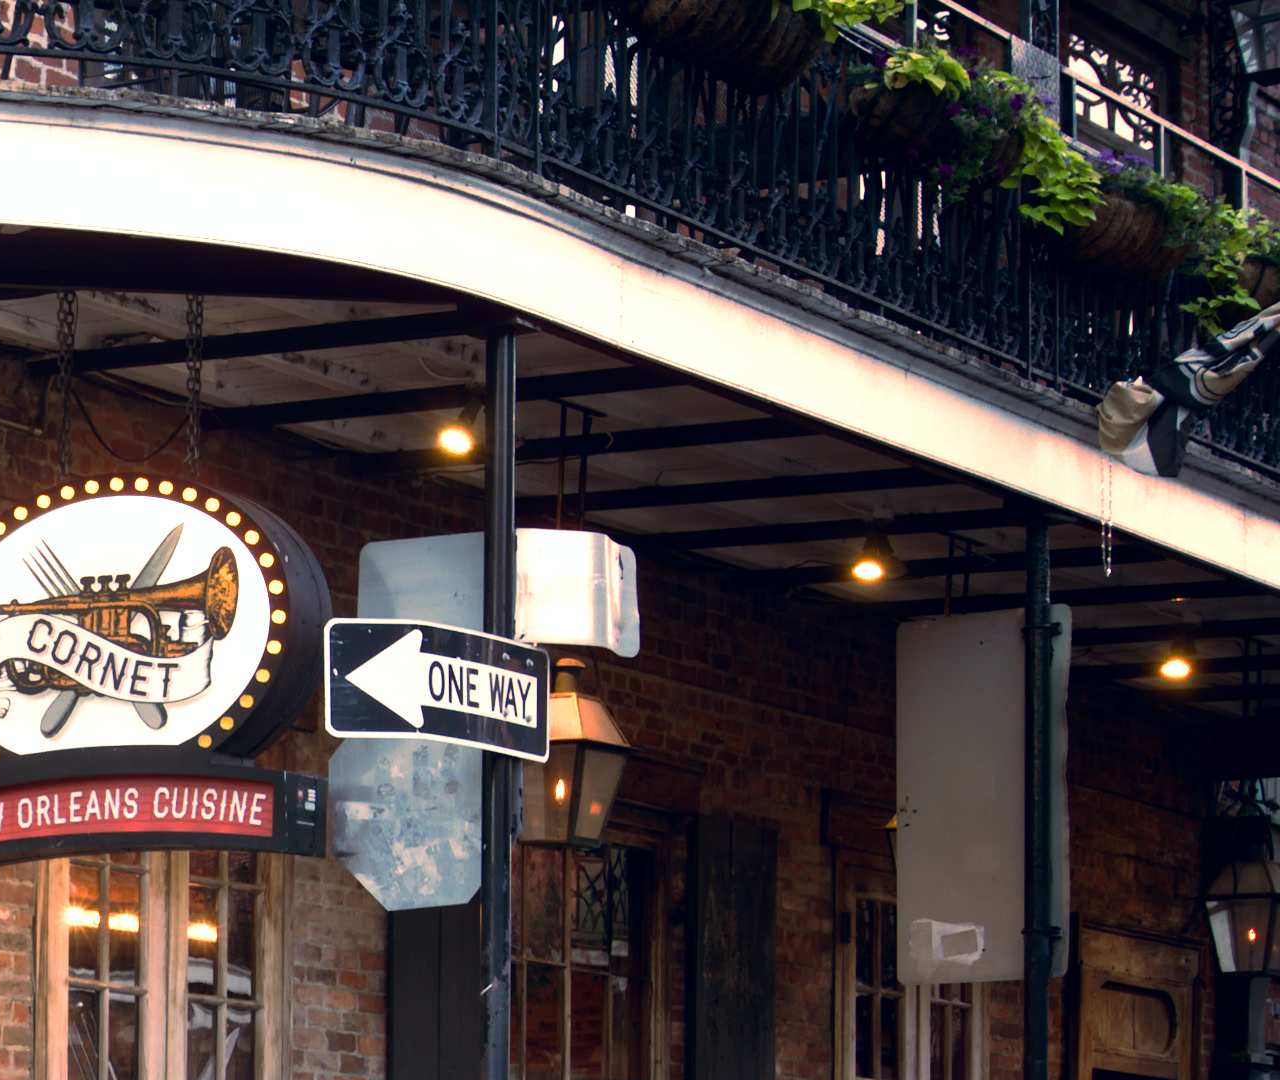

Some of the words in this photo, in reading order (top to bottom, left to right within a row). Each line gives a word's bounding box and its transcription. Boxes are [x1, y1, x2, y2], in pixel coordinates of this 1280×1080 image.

[26, 618, 180, 698] CORNET
[428, 660, 481, 709] ONE
[488, 671, 532, 720] WAY
[16, 787, 139, 829] ORLEANS
[152, 785, 267, 827] CUISINE
